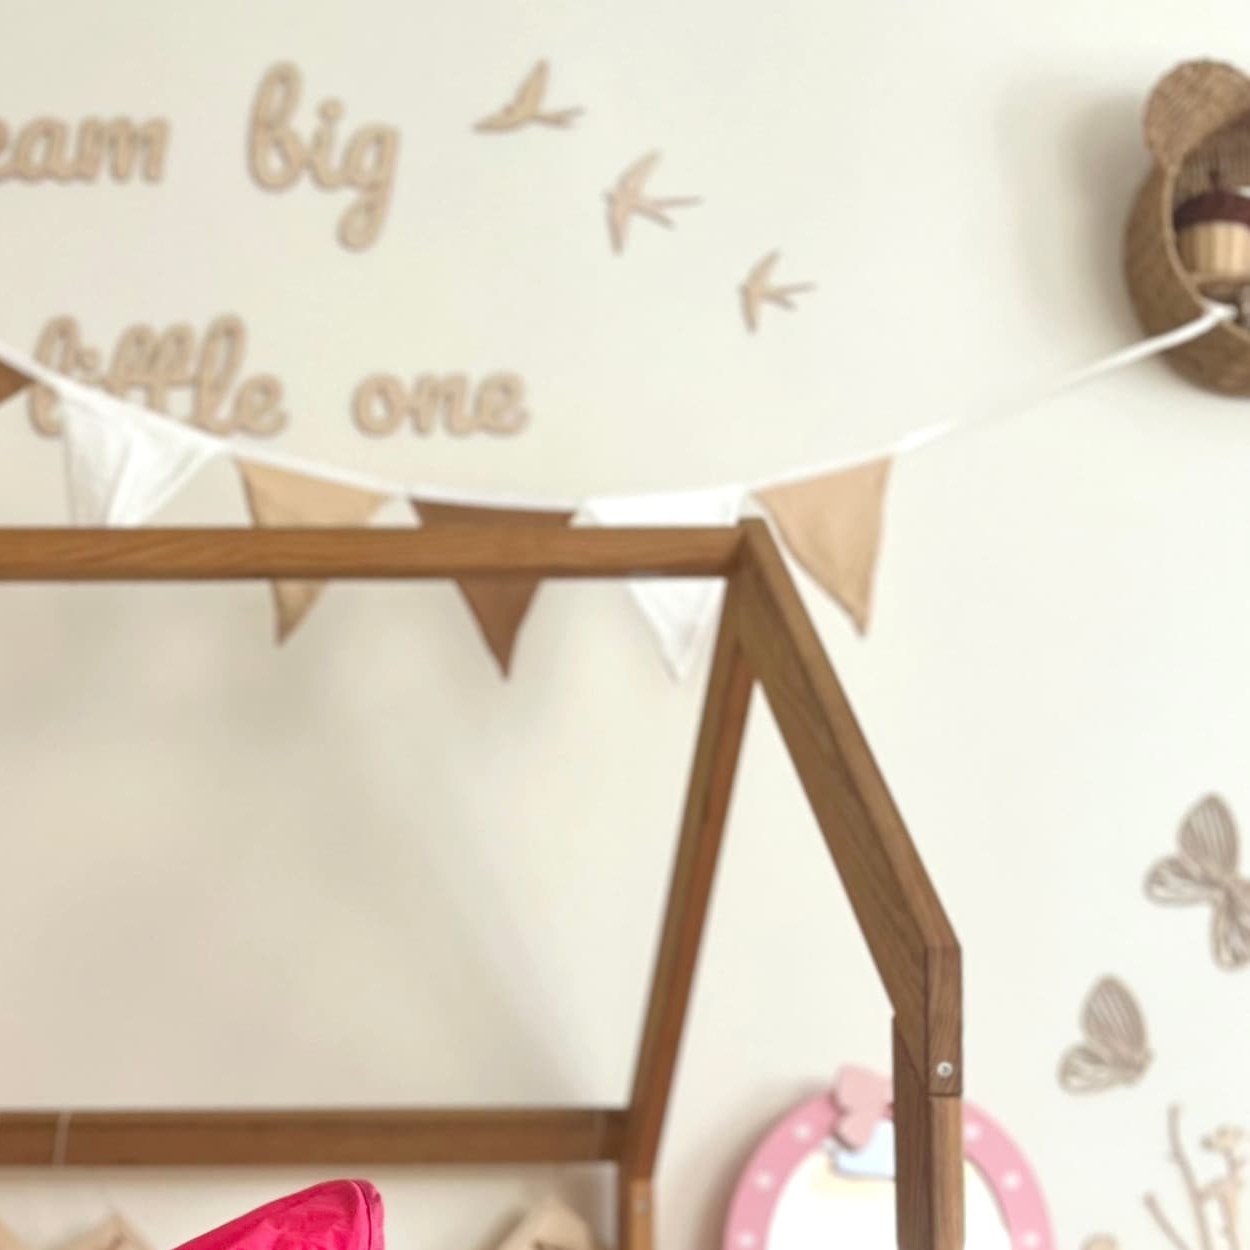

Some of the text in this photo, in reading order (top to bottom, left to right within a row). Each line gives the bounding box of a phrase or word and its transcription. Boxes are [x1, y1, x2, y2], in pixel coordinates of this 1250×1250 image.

[247, 59, 401, 251] big
[27, 314, 530, 439] lttle one
